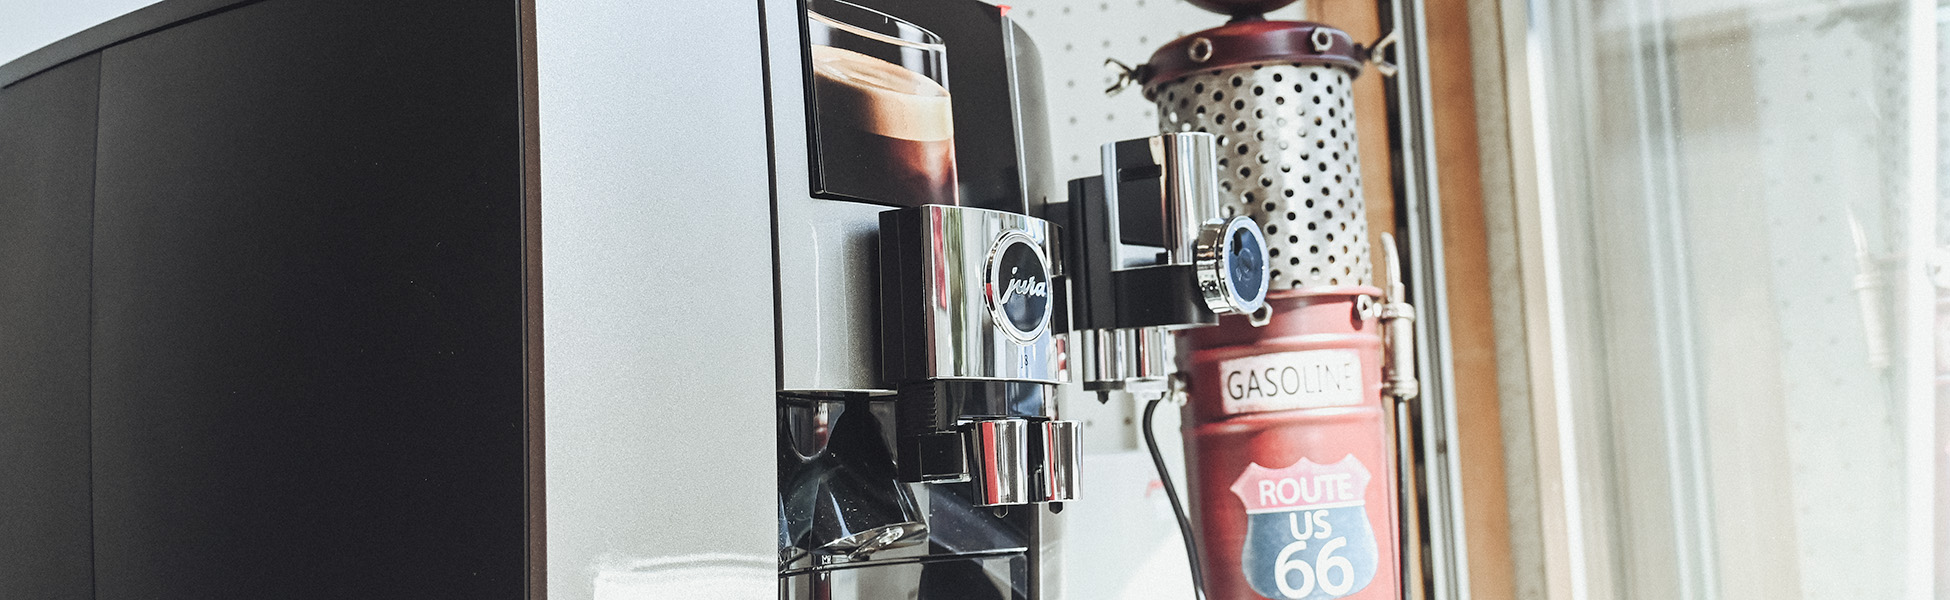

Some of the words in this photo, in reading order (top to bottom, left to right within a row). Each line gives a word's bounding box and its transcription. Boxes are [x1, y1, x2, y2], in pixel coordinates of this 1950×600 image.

[1001, 266, 1047, 305] jura
[1227, 363, 1353, 400] GASOLINE
[1258, 473, 1355, 506] ROUTE
[1289, 509, 1332, 540] US
[1274, 536, 1355, 599] 66
